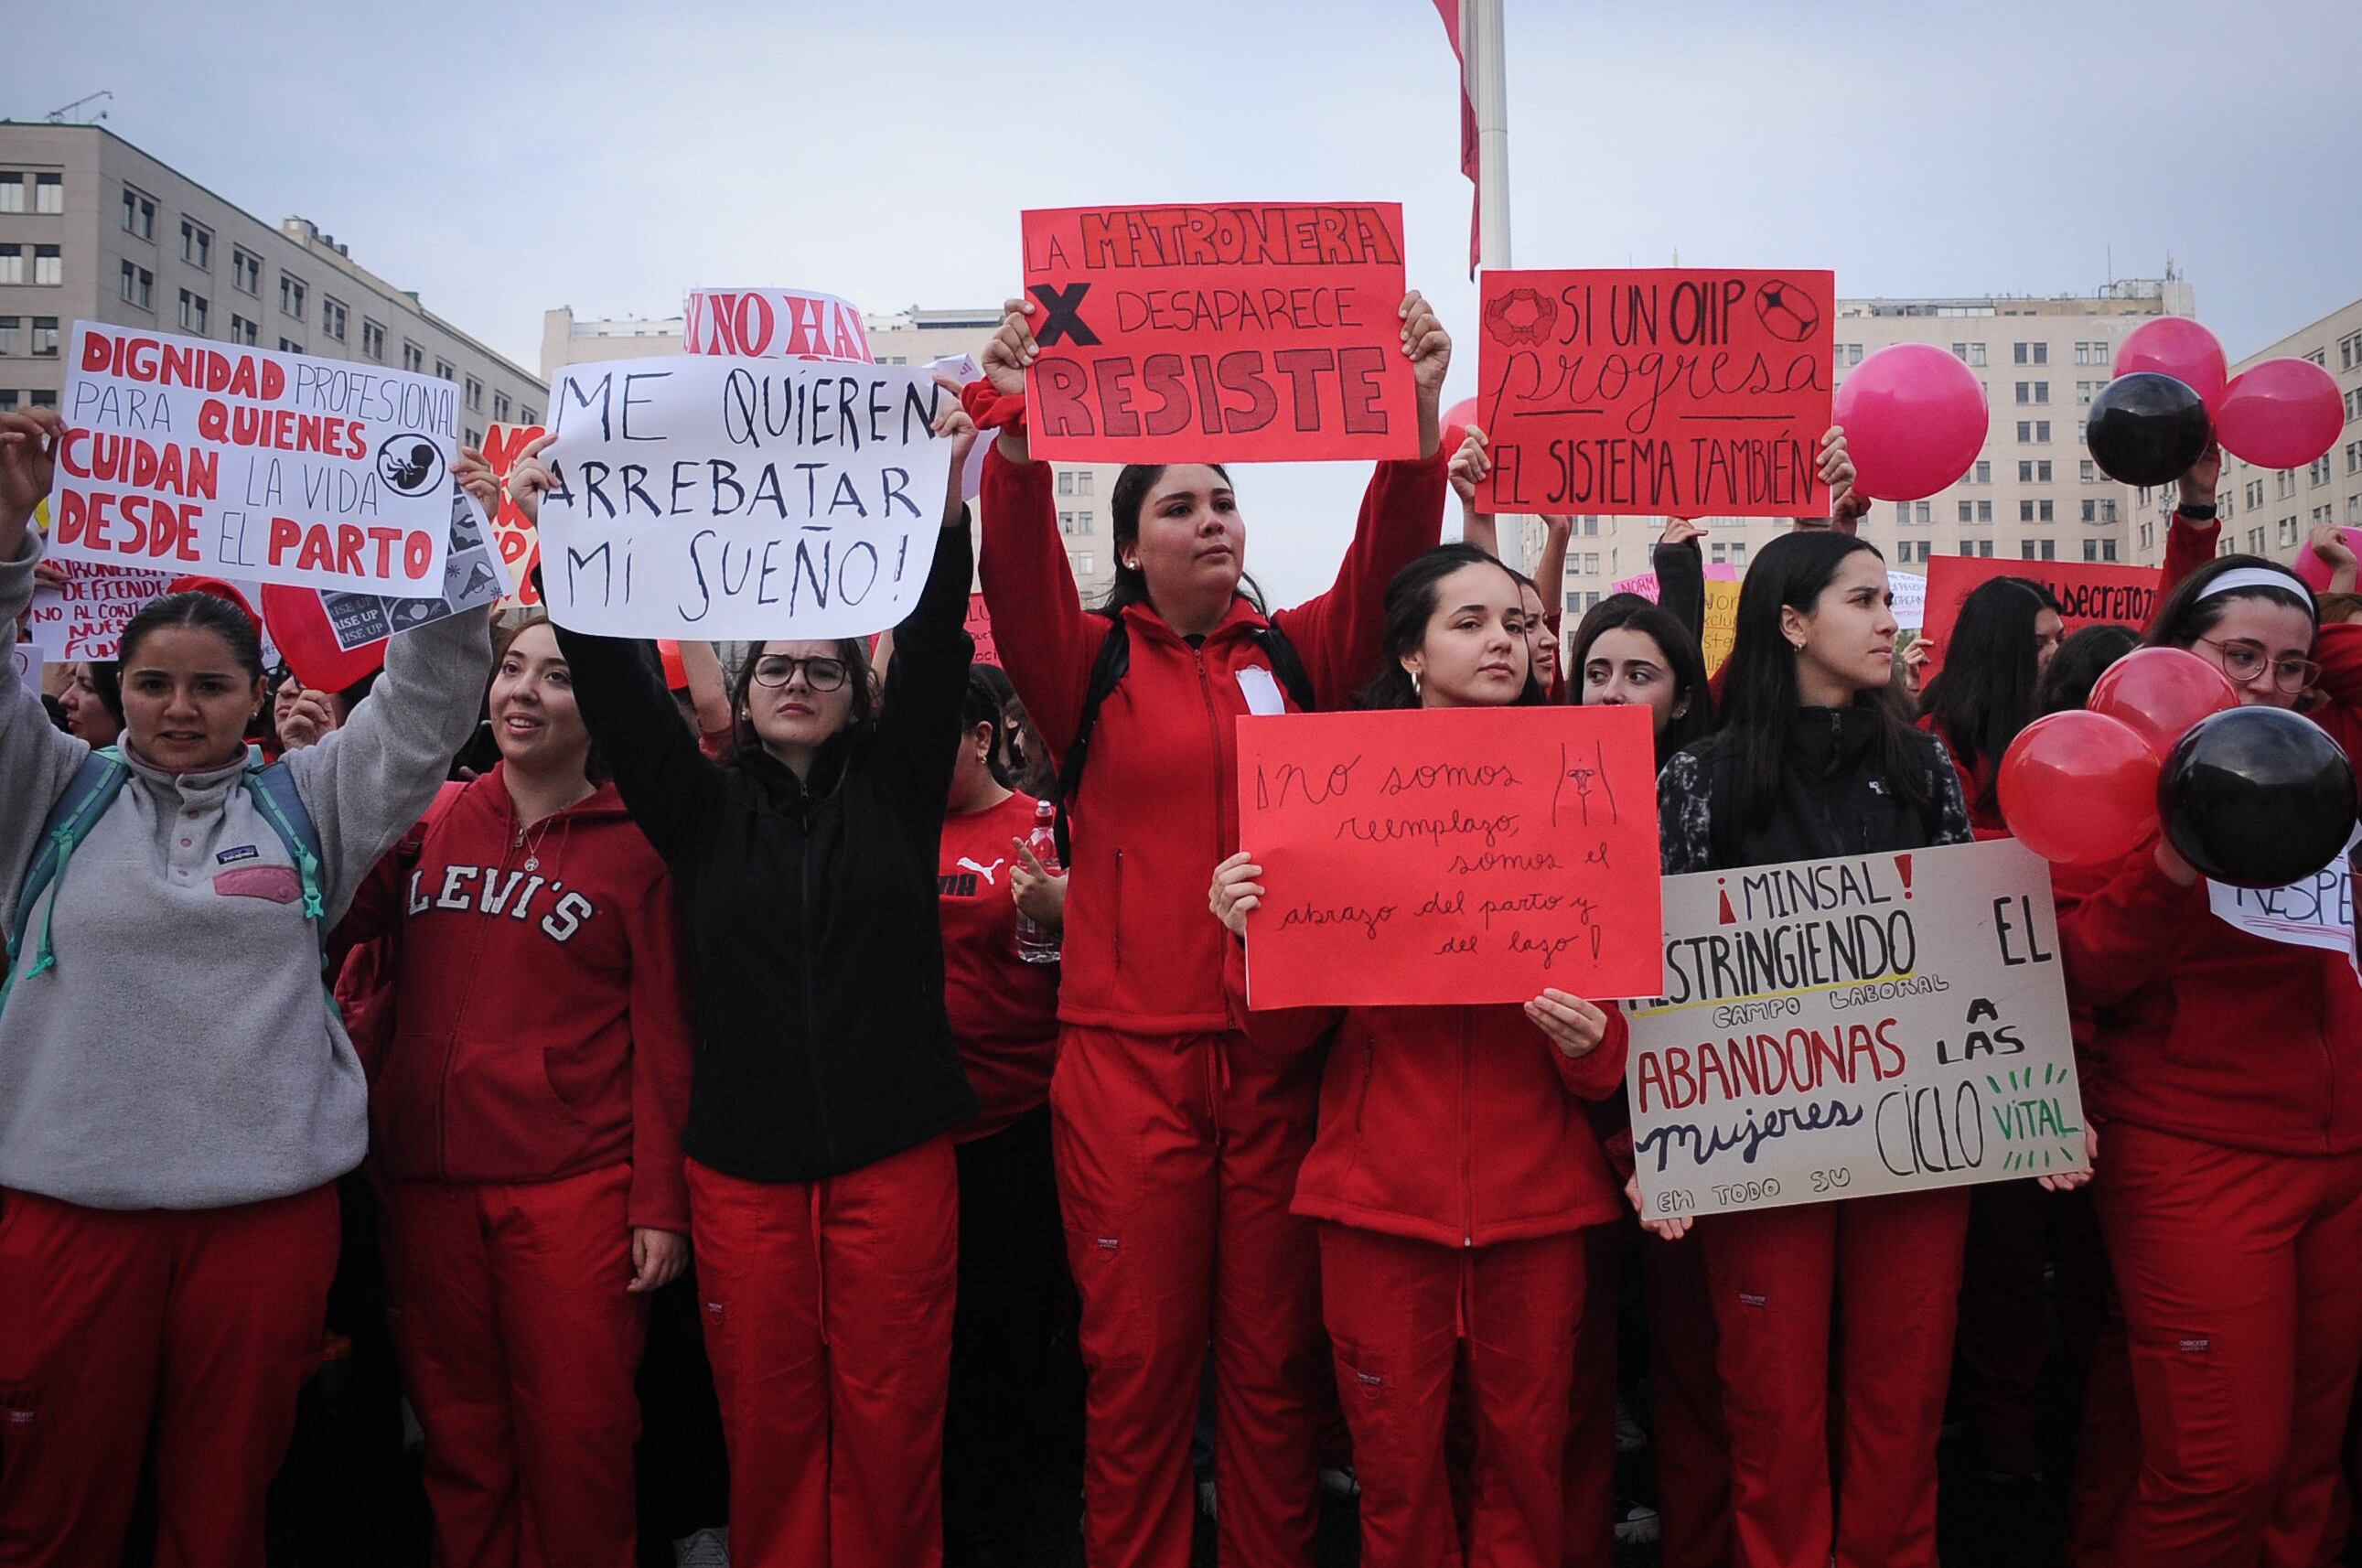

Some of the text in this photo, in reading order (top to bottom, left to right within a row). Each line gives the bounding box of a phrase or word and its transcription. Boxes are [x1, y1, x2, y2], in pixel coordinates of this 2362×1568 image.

[1026, 208, 1401, 272] LA MATRONERIA
[707, 292, 774, 357] NO
[1117, 287, 1362, 333] DESAPARECE
[1559, 285, 1592, 346] SI
[1611, 285, 1658, 346] UN
[81, 330, 456, 439] DIGNIDAD PROFESIONAL
[556, 371, 673, 443] ME
[1036, 347, 1388, 438] RESISTE
[1487, 350, 1828, 435] progresa
[74, 381, 367, 460] PARA QUIENES
[60, 429, 378, 516] CUIDAN LA VIDA
[542, 458, 922, 520] ARREBATAR
[1492, 428, 1816, 506] EL SISTEMA TAMBIÉN
[57, 489, 202, 562] DESDE
[219, 512, 254, 567] EL
[267, 517, 432, 580] PARTO
[678, 525, 909, 622] SUEÑO!
[34, 607, 62, 623] NO
[75, 605, 94, 620] AL
[361, 609, 379, 622] UP
[1380, 762, 1522, 795] somos
[1448, 842, 1610, 874] somos el
[1277, 891, 1598, 940] abrazo del parto y
[1434, 930, 1478, 955] del
[1993, 895, 2052, 966] EL
[1712, 974, 1949, 1028] CAMPO LABORAL
[1966, 998, 1999, 1025] A
[1638, 1018, 2024, 1113] ABANDONAS LAS
[1635, 1100, 1863, 1172] mujeres
[1712, 1178, 1780, 1208] TODO
[1810, 1168, 1850, 1191] SU
